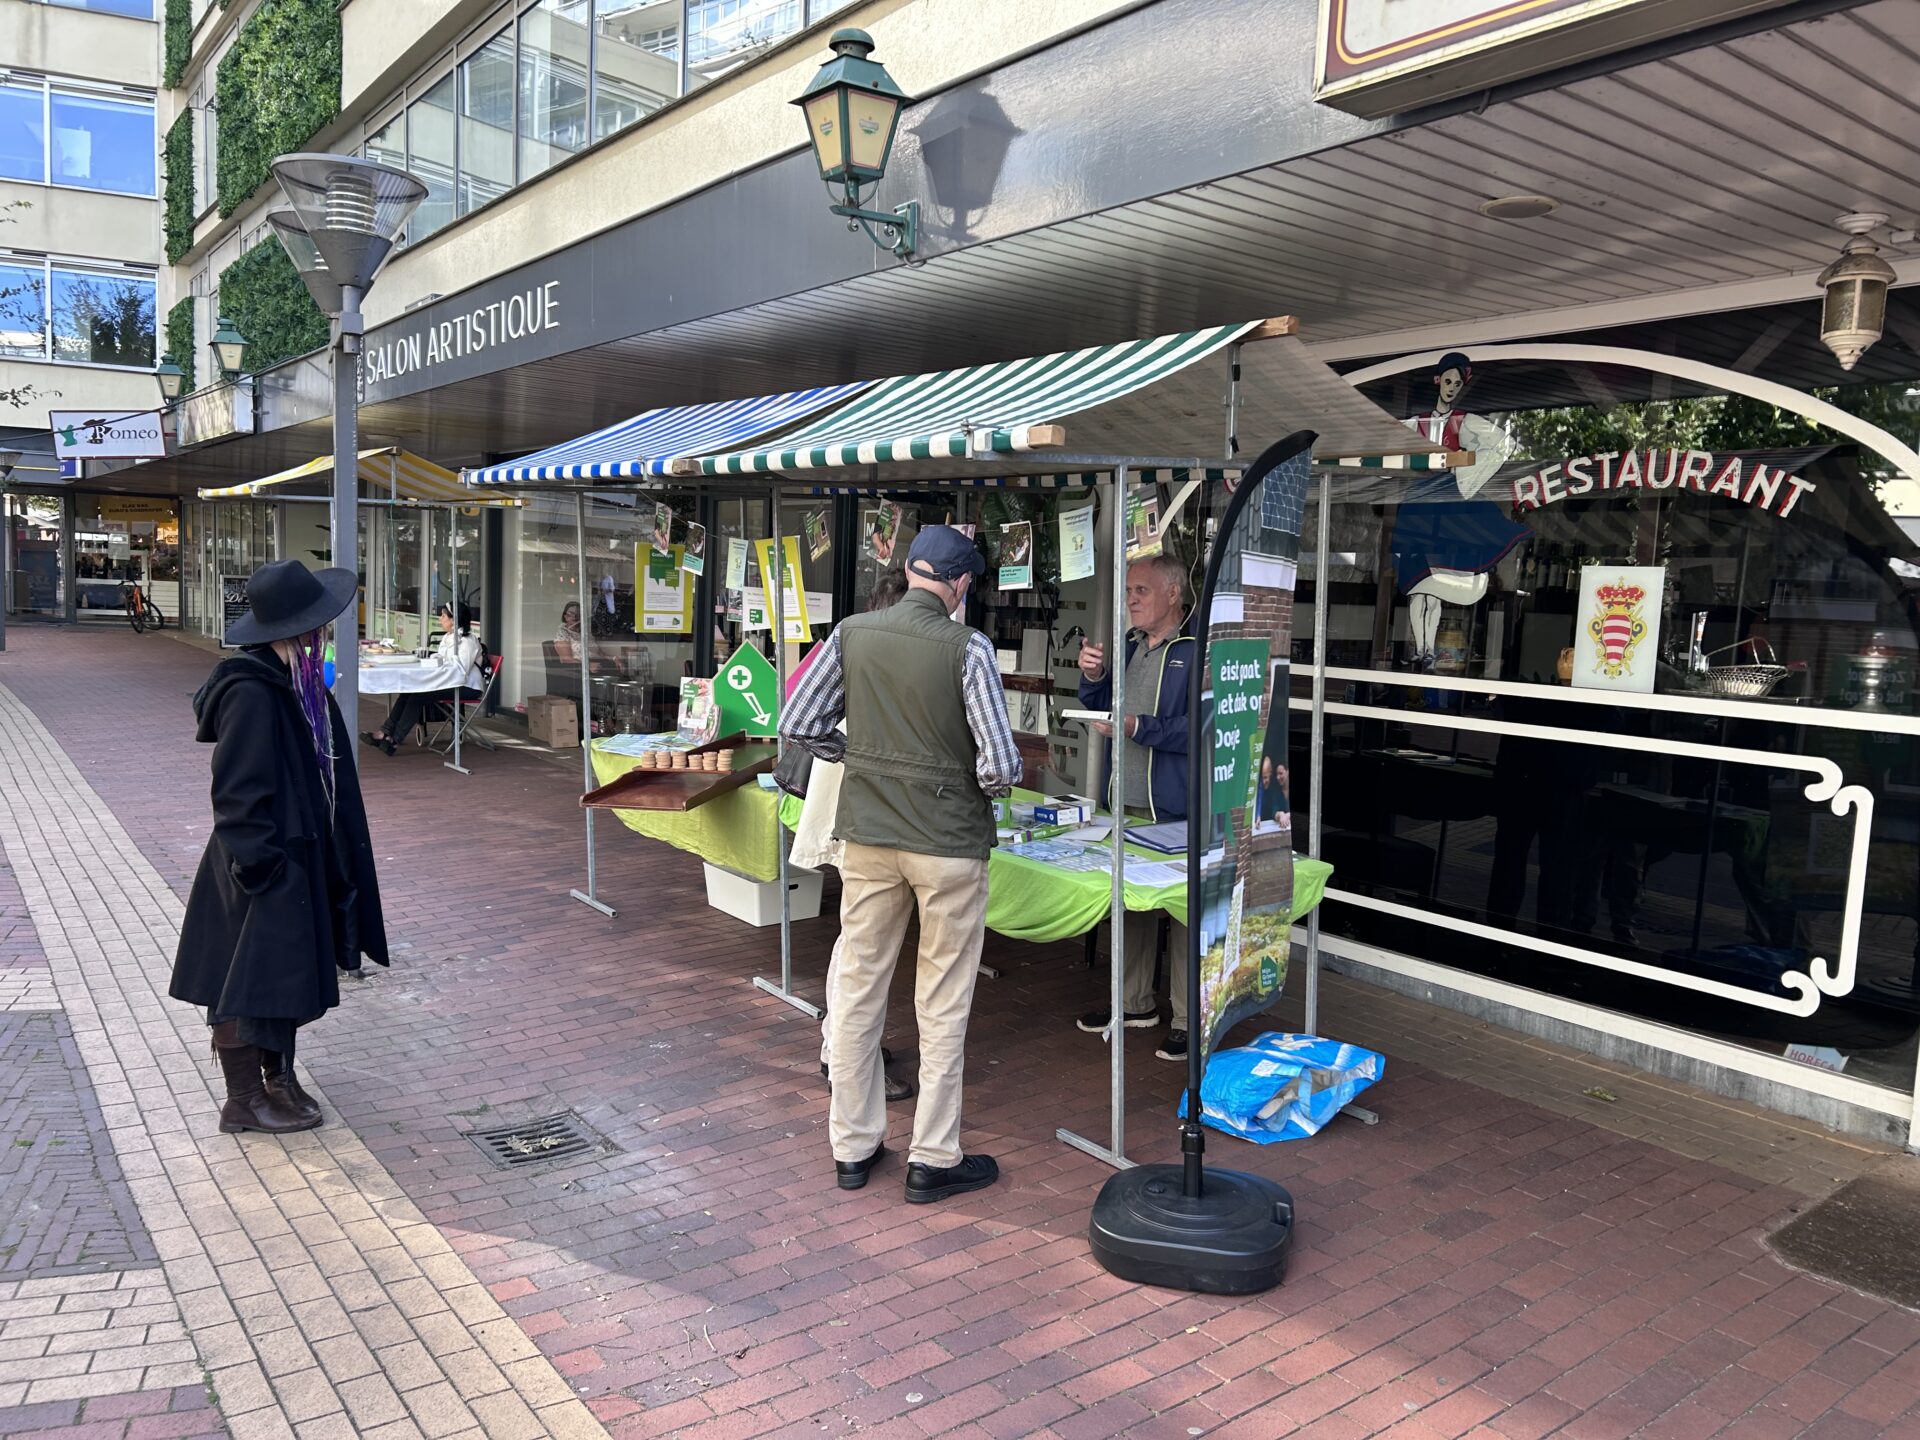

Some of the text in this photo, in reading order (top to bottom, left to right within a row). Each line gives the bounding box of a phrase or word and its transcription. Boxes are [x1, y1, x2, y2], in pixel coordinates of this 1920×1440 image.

[366, 333, 421, 385] SALON
[426, 280, 560, 367] ARTISTIQUE
[94, 425, 158, 441] Romeo
[1512, 447, 1817, 519] RESTAURANT
[1789, 1048, 1836, 1071] HORECA
